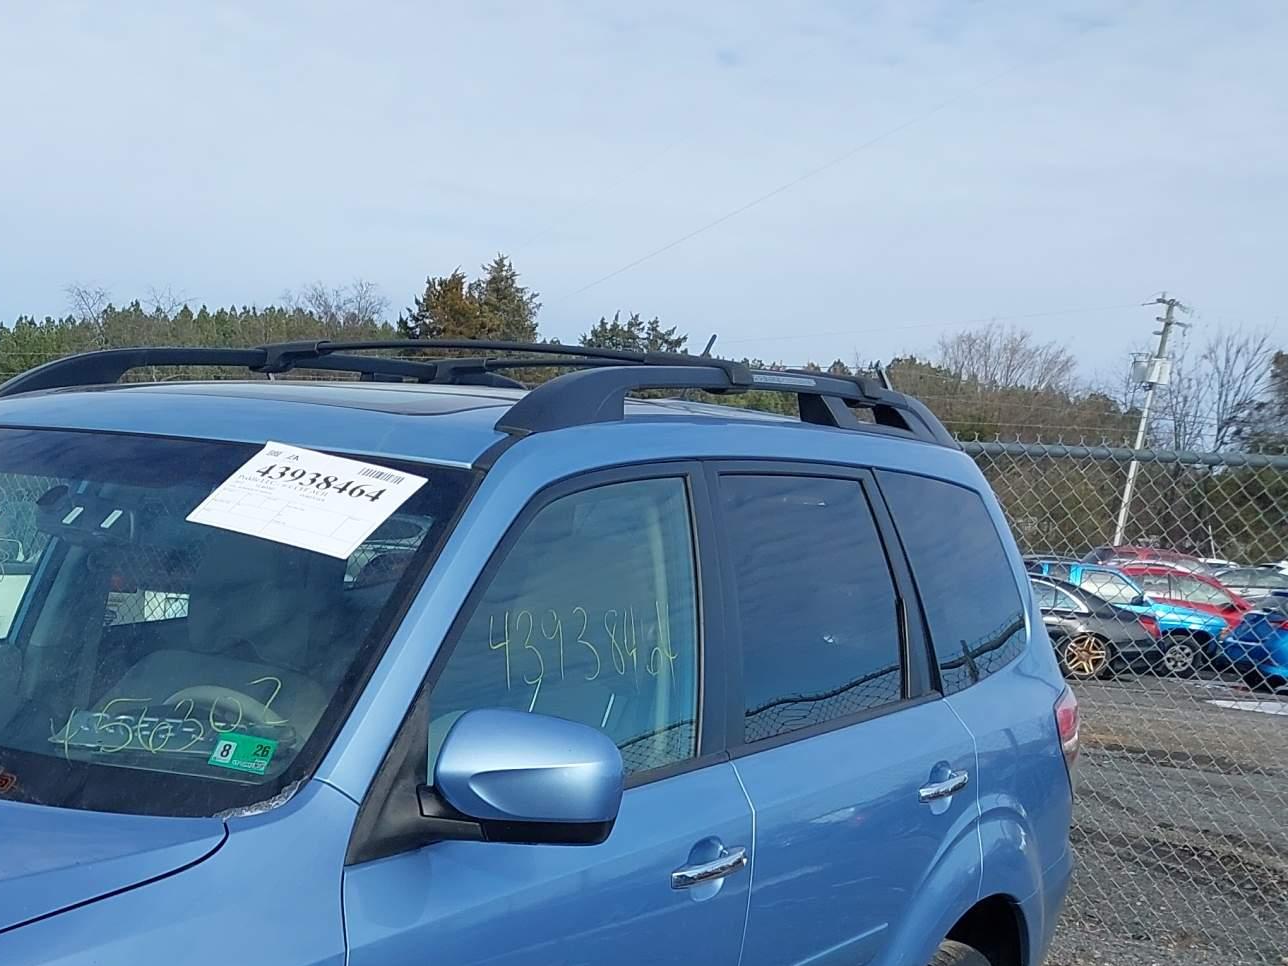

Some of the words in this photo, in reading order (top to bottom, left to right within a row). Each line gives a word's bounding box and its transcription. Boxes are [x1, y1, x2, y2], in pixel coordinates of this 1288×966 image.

[256, 463, 387, 502] 43938464
[220, 743, 232, 758] 8
[253, 744, 271, 758] 26
